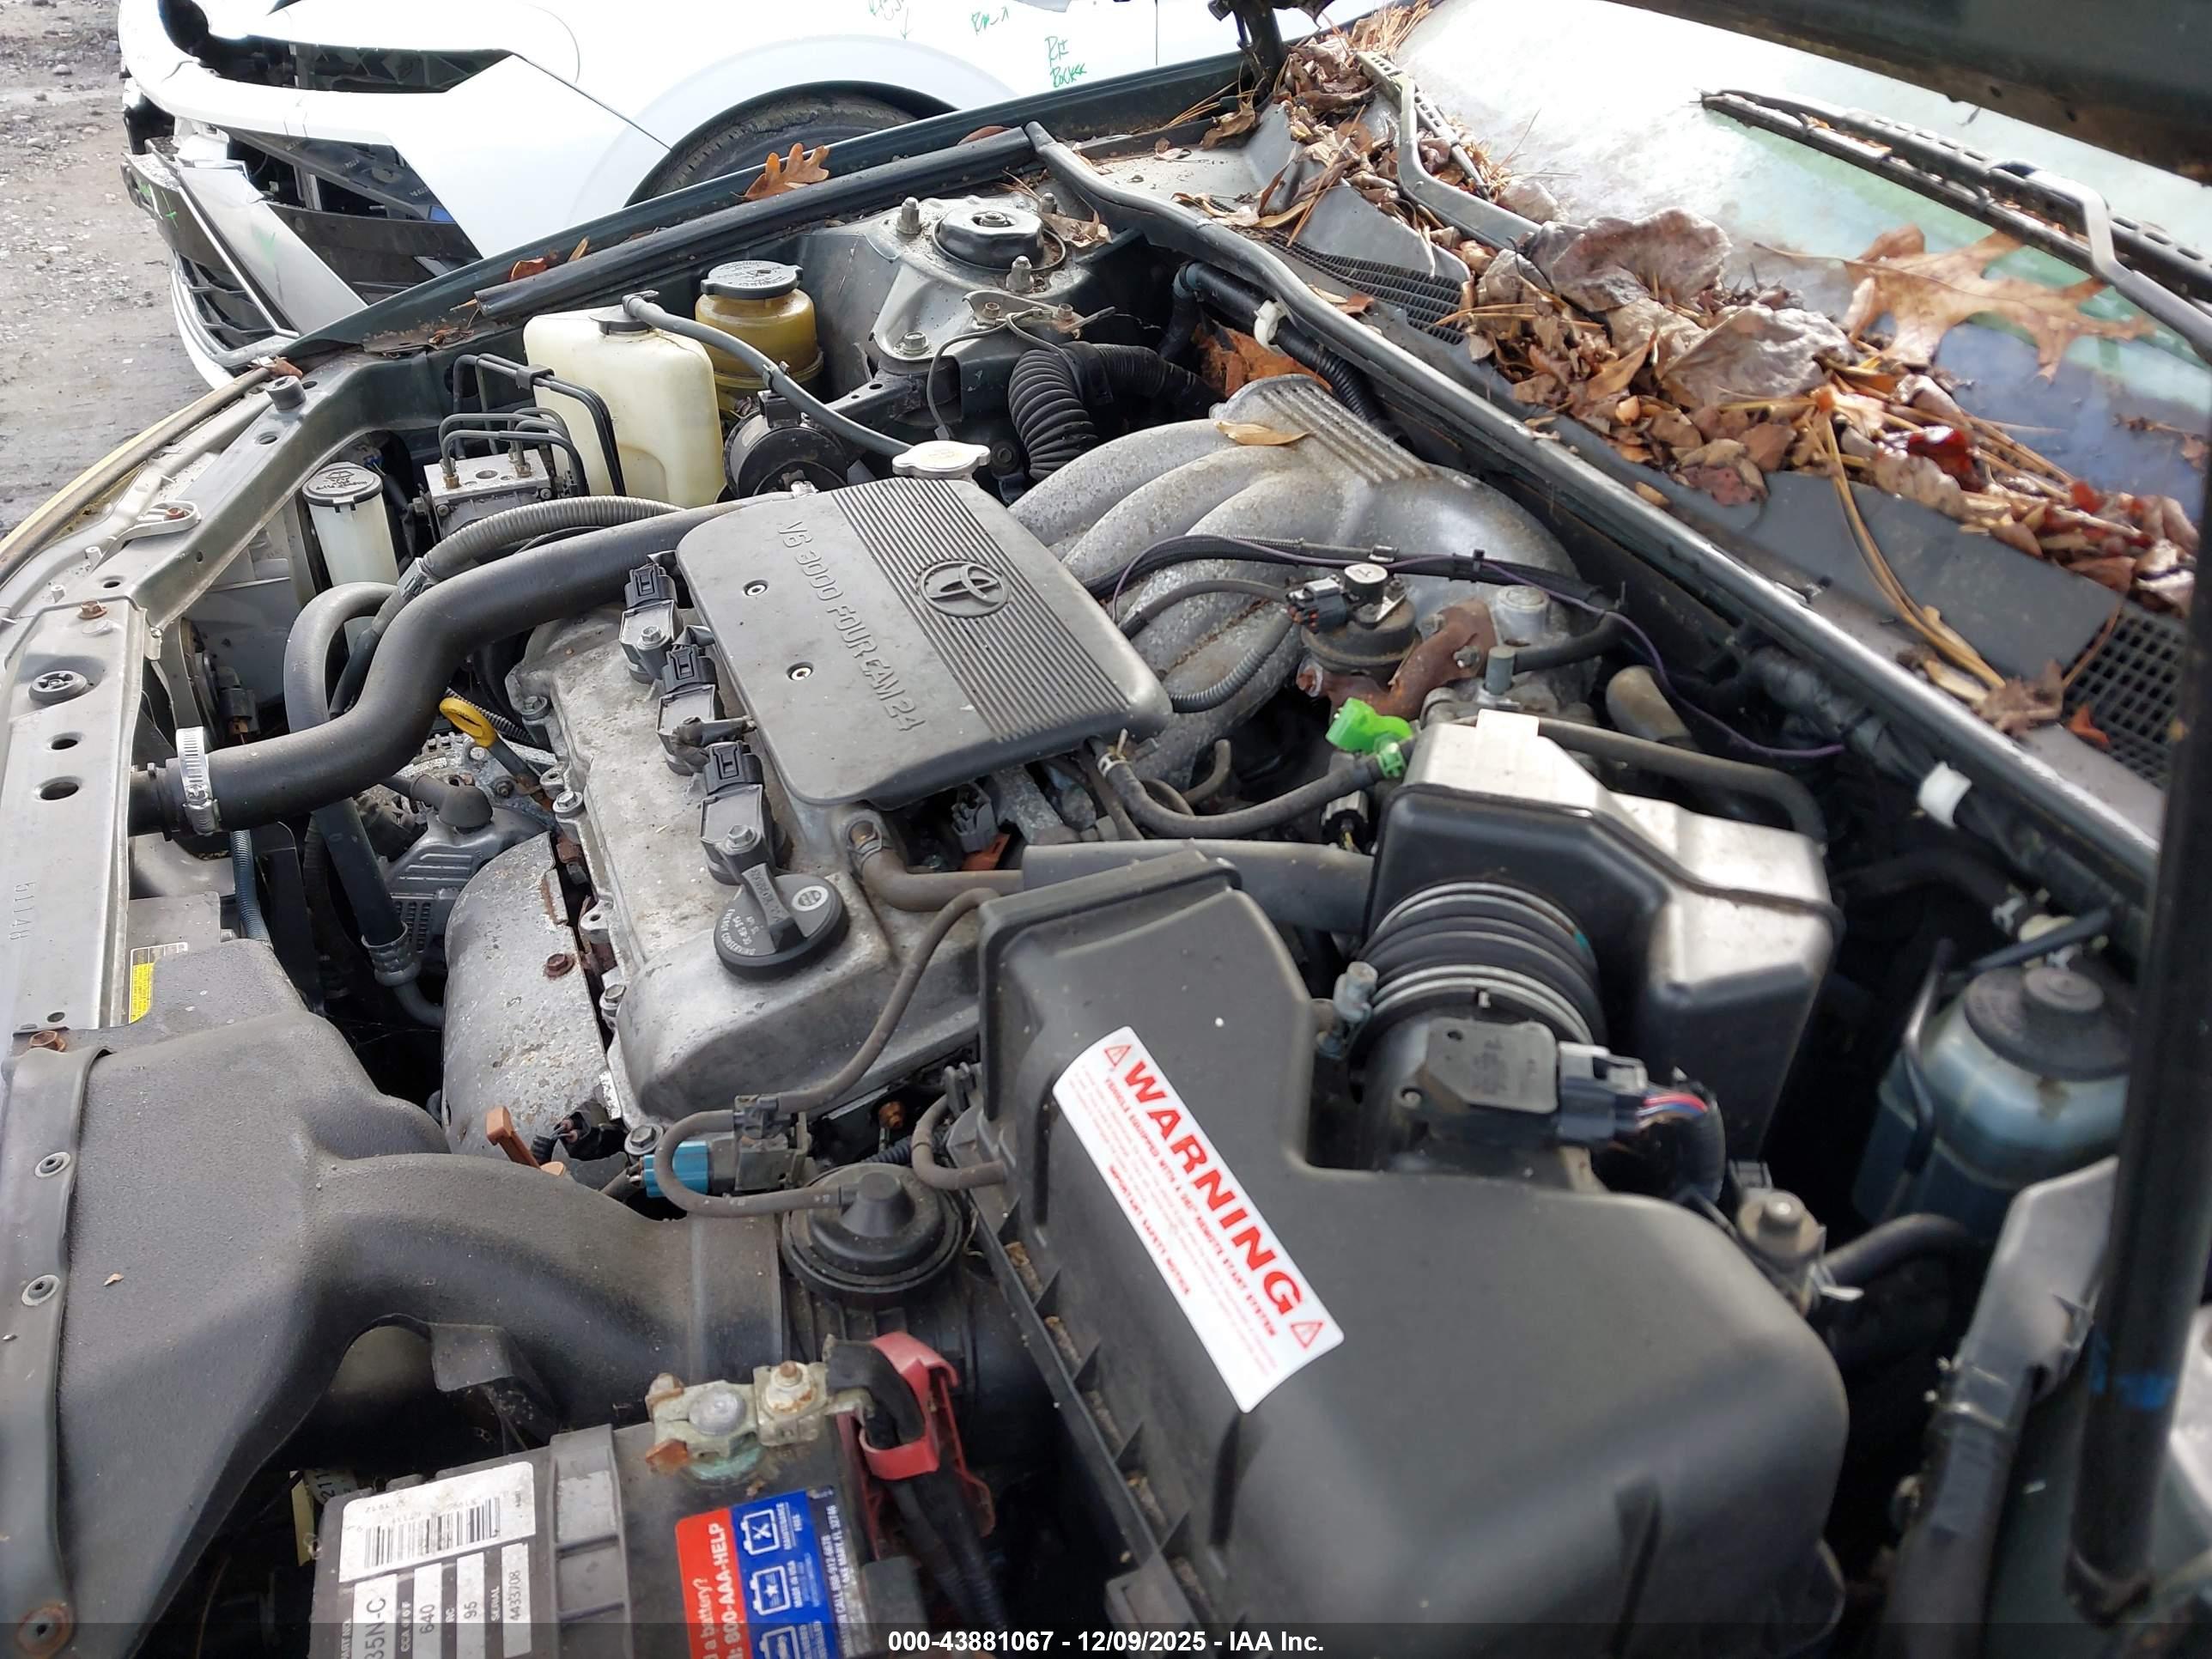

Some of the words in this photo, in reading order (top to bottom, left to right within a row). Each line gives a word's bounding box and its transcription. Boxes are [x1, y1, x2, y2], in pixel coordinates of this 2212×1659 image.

[778, 521, 812, 548] V6
[796, 550, 844, 601] 3000
[827, 605, 878, 659] FOUR
[861, 659, 906, 702] CAM
[885, 697, 927, 732] 24
[1125, 1060, 1301, 1316] WARNING
[1128, 1114, 1159, 1158] EQUIPPED
[1196, 1216, 1224, 1255] REMOTE
[1223, 1257, 1248, 1290] START
[1246, 1294, 1276, 1336] SYSTEM
[776, 1503, 792, 1550] MAINTENANCE
[792, 1514, 802, 1531] FREE
[787, 1560, 797, 1575] USA
[708, 1522, 741, 1644] 800-AAA-HELP
[790, 1576, 799, 1585] IN
[490, 1586, 501, 1622] SERIAL
[693, 1577, 715, 1638] battery?
[791, 1586, 803, 1607] MADE
[832, 1591, 846, 1613] CALL
[419, 1604, 435, 1634] 640
[446, 1607, 455, 1623] RC
[464, 1601, 477, 1620] 95
[401, 1628, 411, 1651] CCA
[704, 1639, 716, 1650] a
